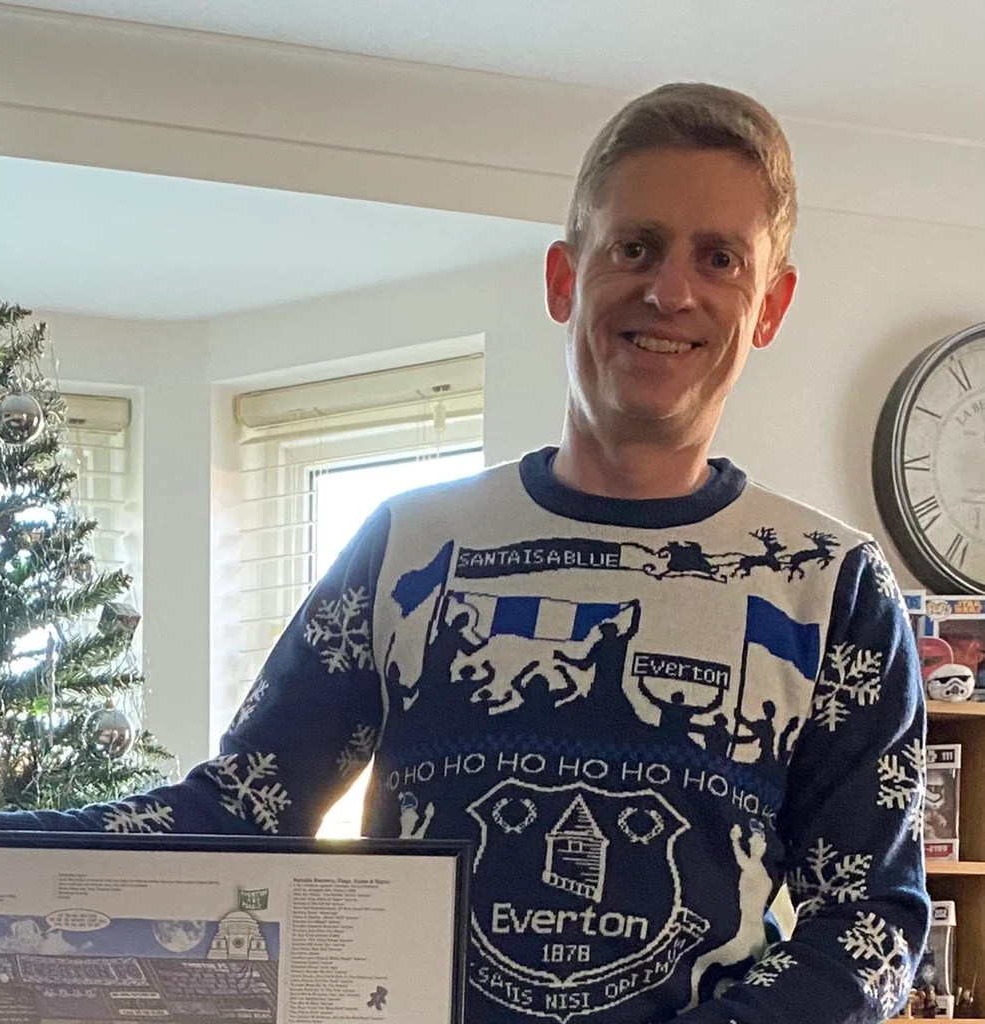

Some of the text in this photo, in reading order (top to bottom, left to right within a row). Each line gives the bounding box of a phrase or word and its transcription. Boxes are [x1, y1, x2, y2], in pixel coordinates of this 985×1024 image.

[634, 655, 728, 686] Everton
[404, 761, 435, 785] HO
[444, 752, 485, 777] HO
[498, 752, 546, 773] HO
[559, 757, 608, 779] HO
[622, 761, 671, 784] HO
[683, 768, 728, 797] HO
[731, 788, 759, 814] HO
[492, 902, 649, 940] Everton
[541, 943, 591, 963] 1878
[477, 966, 533, 1005] SATIS
[545, 992, 591, 1010] NISI
